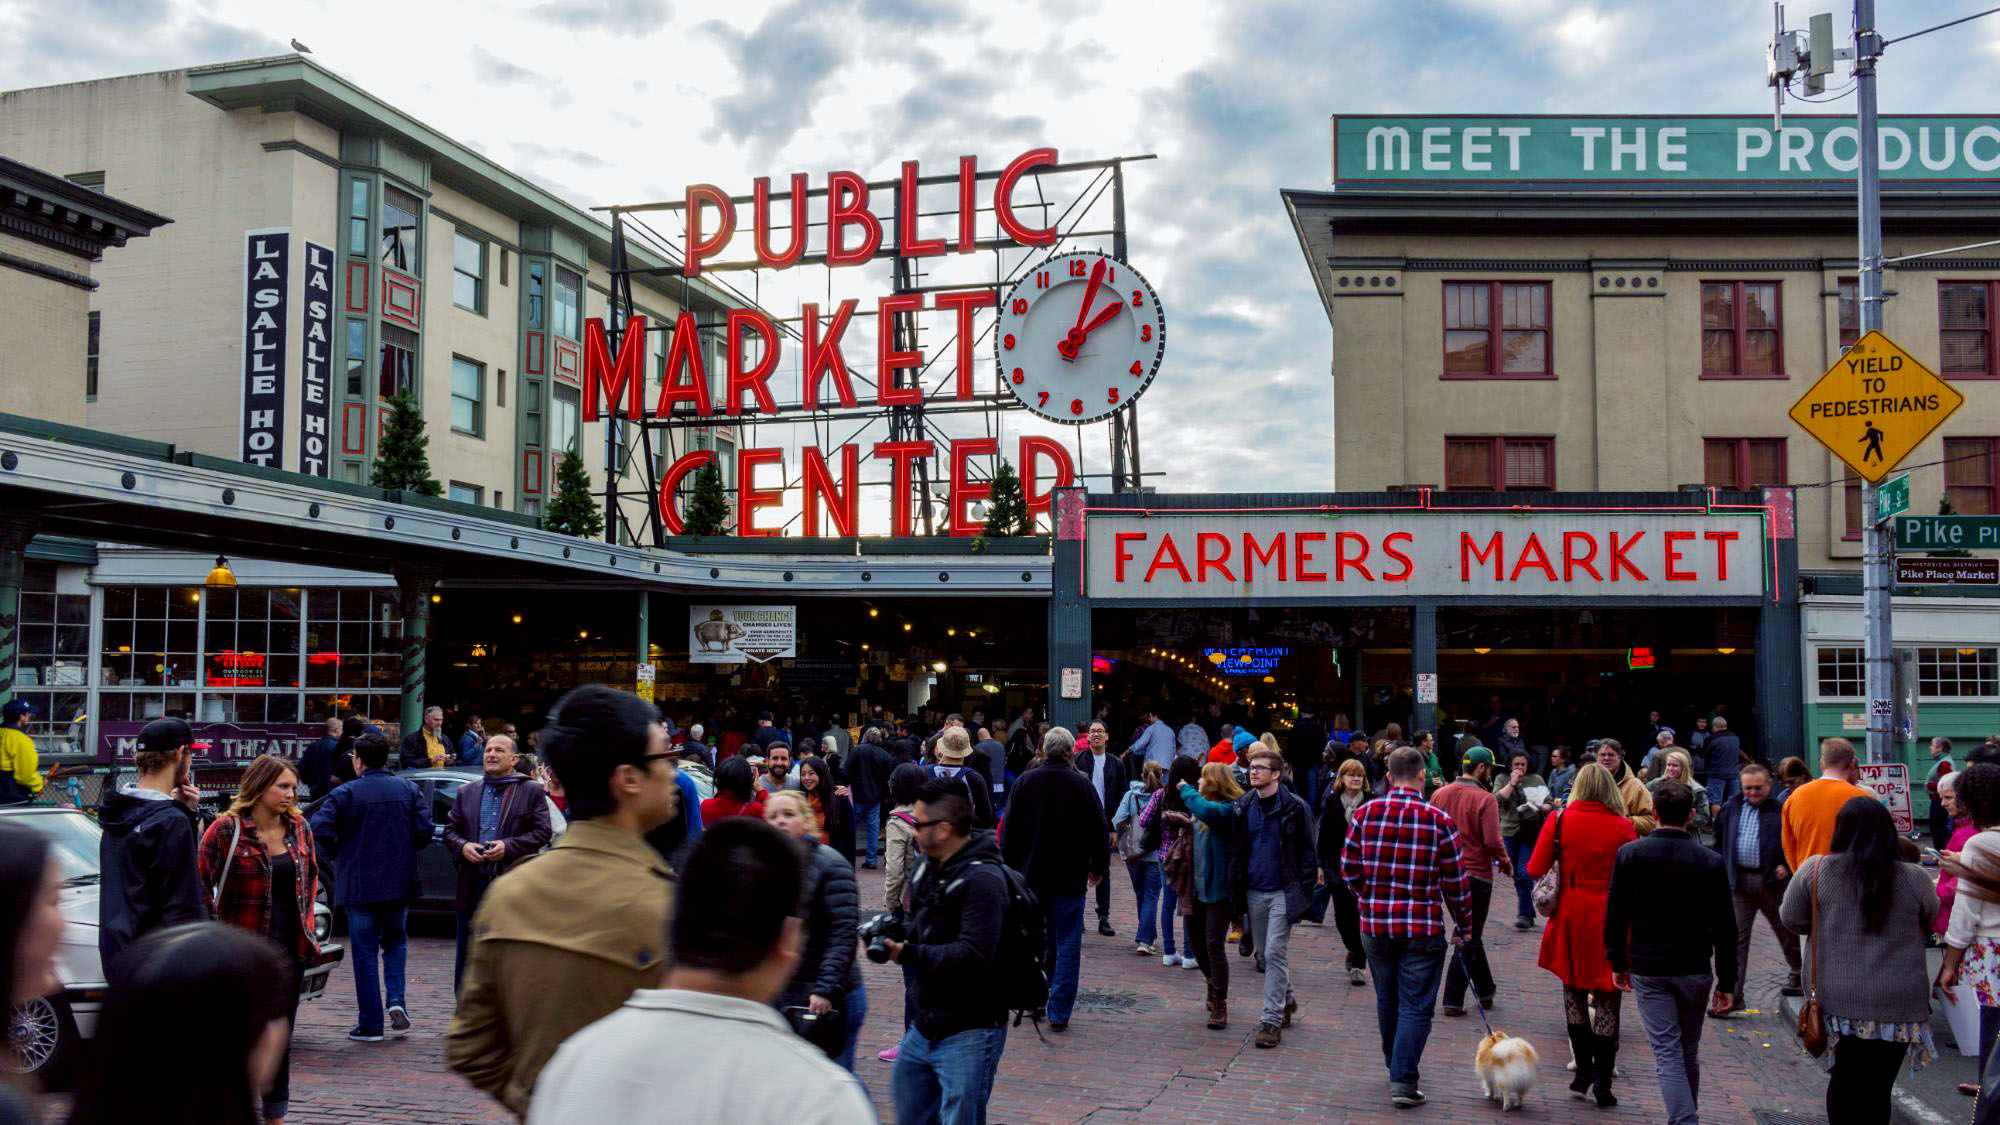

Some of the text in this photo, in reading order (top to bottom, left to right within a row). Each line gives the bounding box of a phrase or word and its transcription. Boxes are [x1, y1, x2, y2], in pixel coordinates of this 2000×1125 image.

[1366, 125, 2000, 172] MEET THE PRODUC
[684, 148, 1059, 278] PUBLIC
[1069, 259, 1086, 277] 12
[1109, 266, 1115, 283] 1
[1037, 271, 1050, 288] 11
[1012, 298, 1028, 315] 10
[1132, 289, 1143, 306] 2
[1003, 333, 1016, 350] 9
[1140, 324, 1152, 342] 3
[248, 240, 280, 467] LA SALLE HOT
[305, 247, 328, 477] LA SALLE HOT
[583, 290, 997, 422] MARKET
[1129, 359, 1143, 377] 4
[1847, 356, 1903, 375] YIELD
[1012, 367, 1024, 384] 8
[1862, 377, 1886, 394] TO
[1038, 391, 1050, 408] 7
[1107, 387, 1120, 404] 5
[1071, 398, 1083, 415] 6
[1811, 394, 1939, 419] PEDESTRIANS
[659, 435, 1075, 537] CENTER
[1905, 519, 1998, 544] Pike Pl
[1115, 530, 1739, 583] FARMERS MARKET
[1900, 570, 1996, 580] Pike Place Market
[220, 738, 315, 759] THEATE
